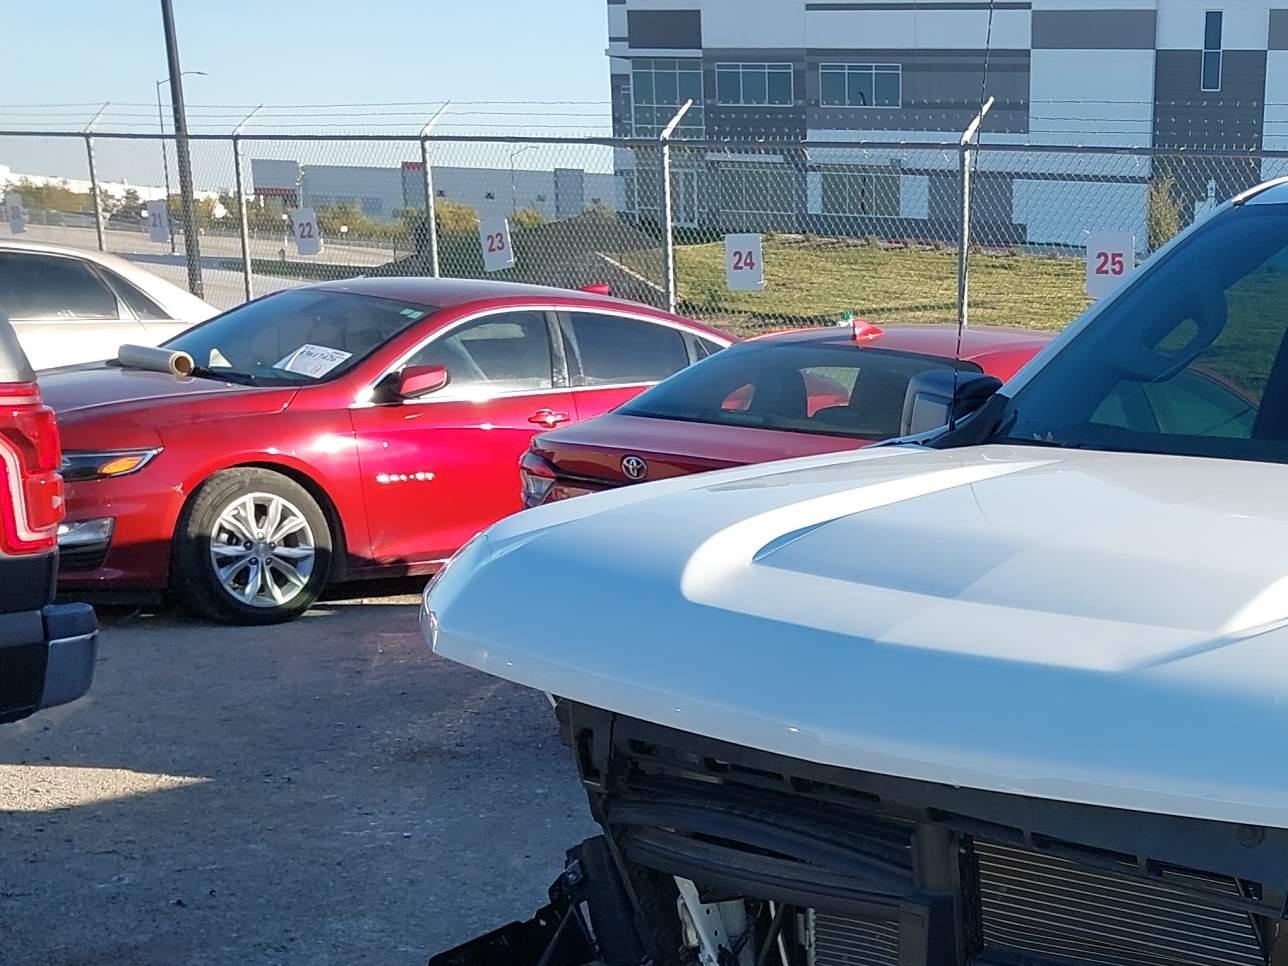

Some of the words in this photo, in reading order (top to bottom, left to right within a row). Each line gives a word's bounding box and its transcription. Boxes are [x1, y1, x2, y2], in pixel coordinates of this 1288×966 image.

[151, 212, 163, 228] 21
[298, 221, 314, 239] 22
[486, 232, 506, 253] 23
[732, 249, 756, 271] 24
[1094, 252, 1125, 276] 25
